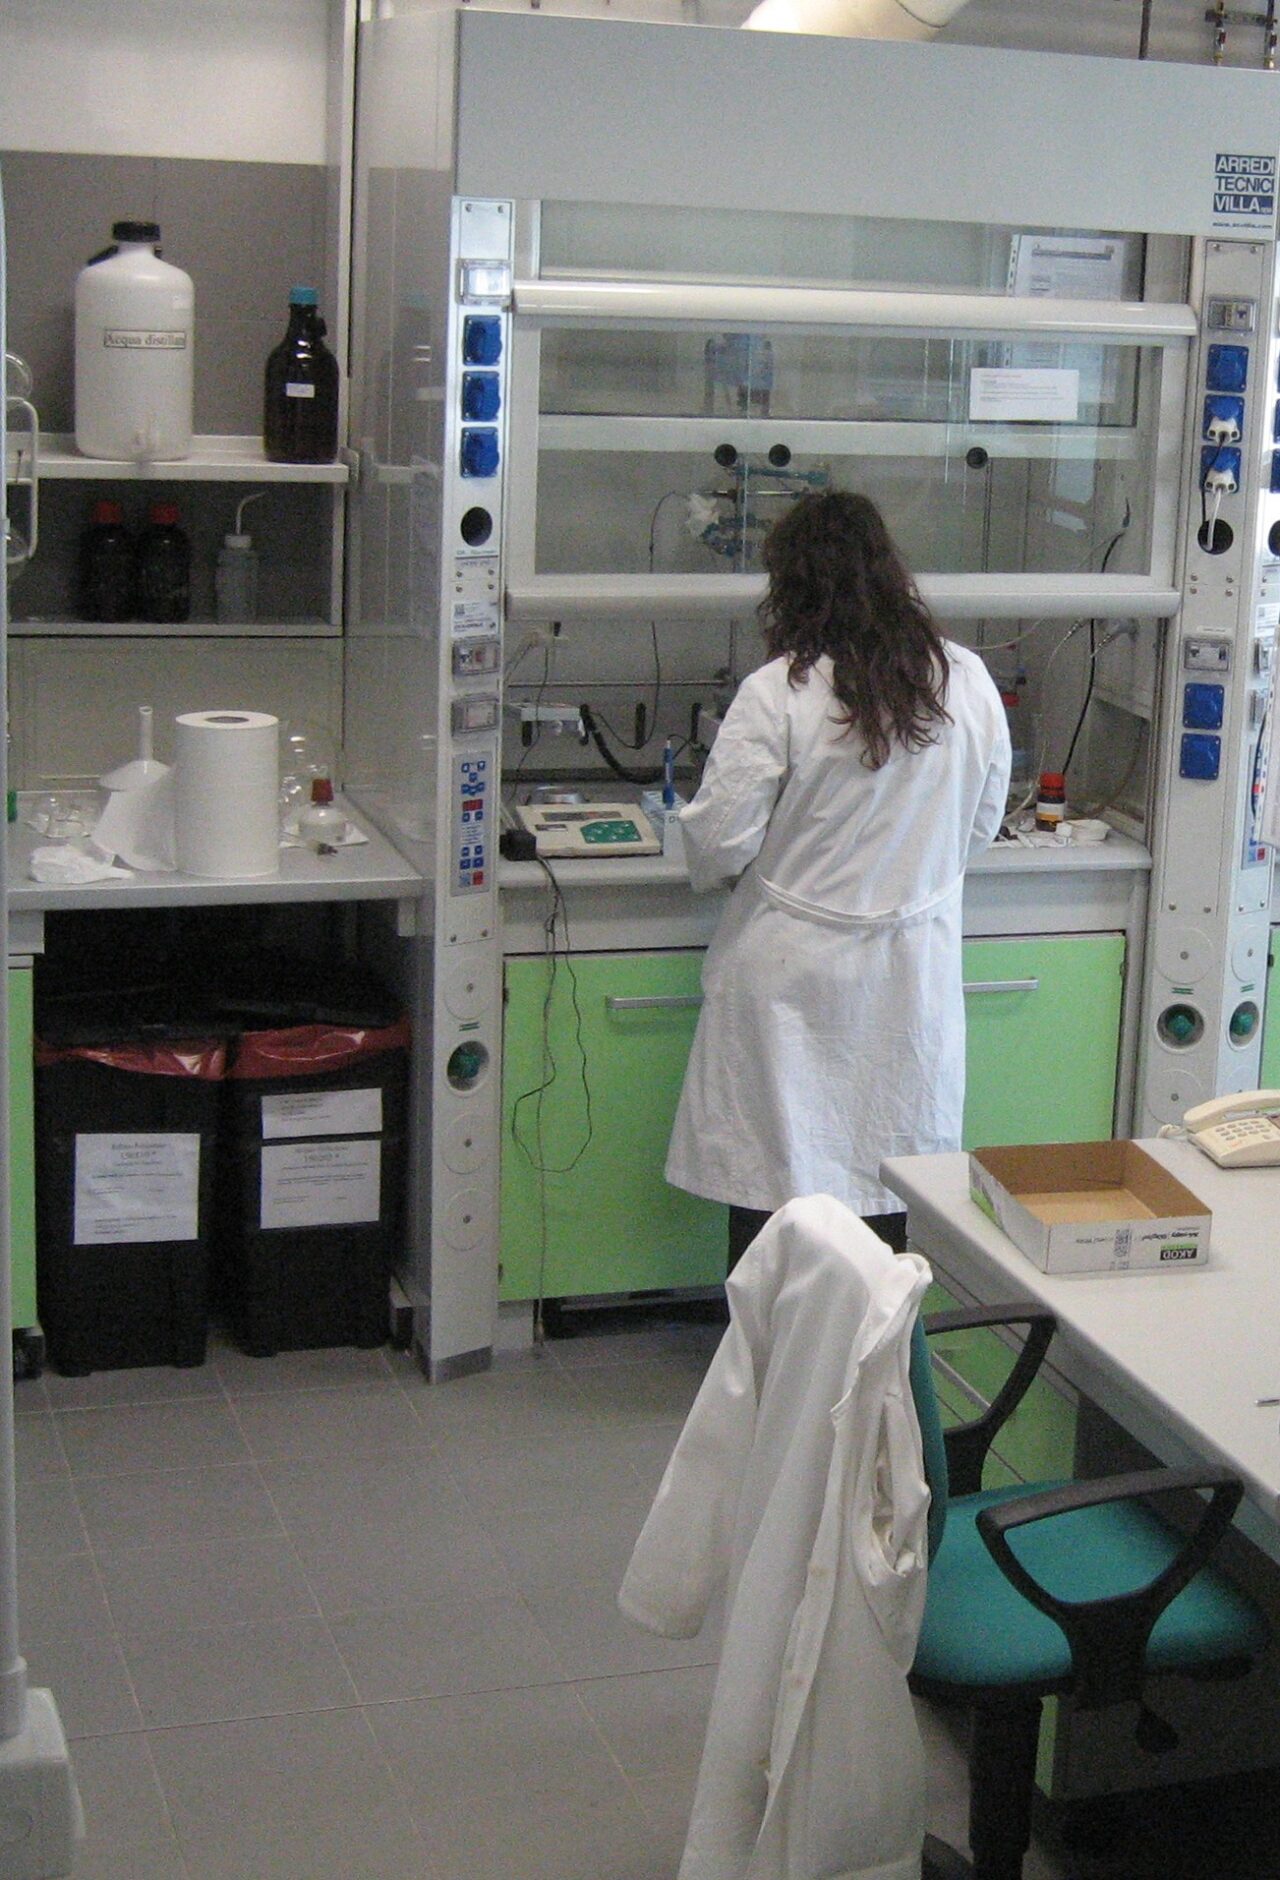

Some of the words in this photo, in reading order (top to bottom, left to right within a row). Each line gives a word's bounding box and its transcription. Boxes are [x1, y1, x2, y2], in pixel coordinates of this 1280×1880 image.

[1216, 156, 1275, 175] ARREDI
[1215, 175, 1275, 193] TECNICI
[1214, 195, 1261, 213] VILLA
